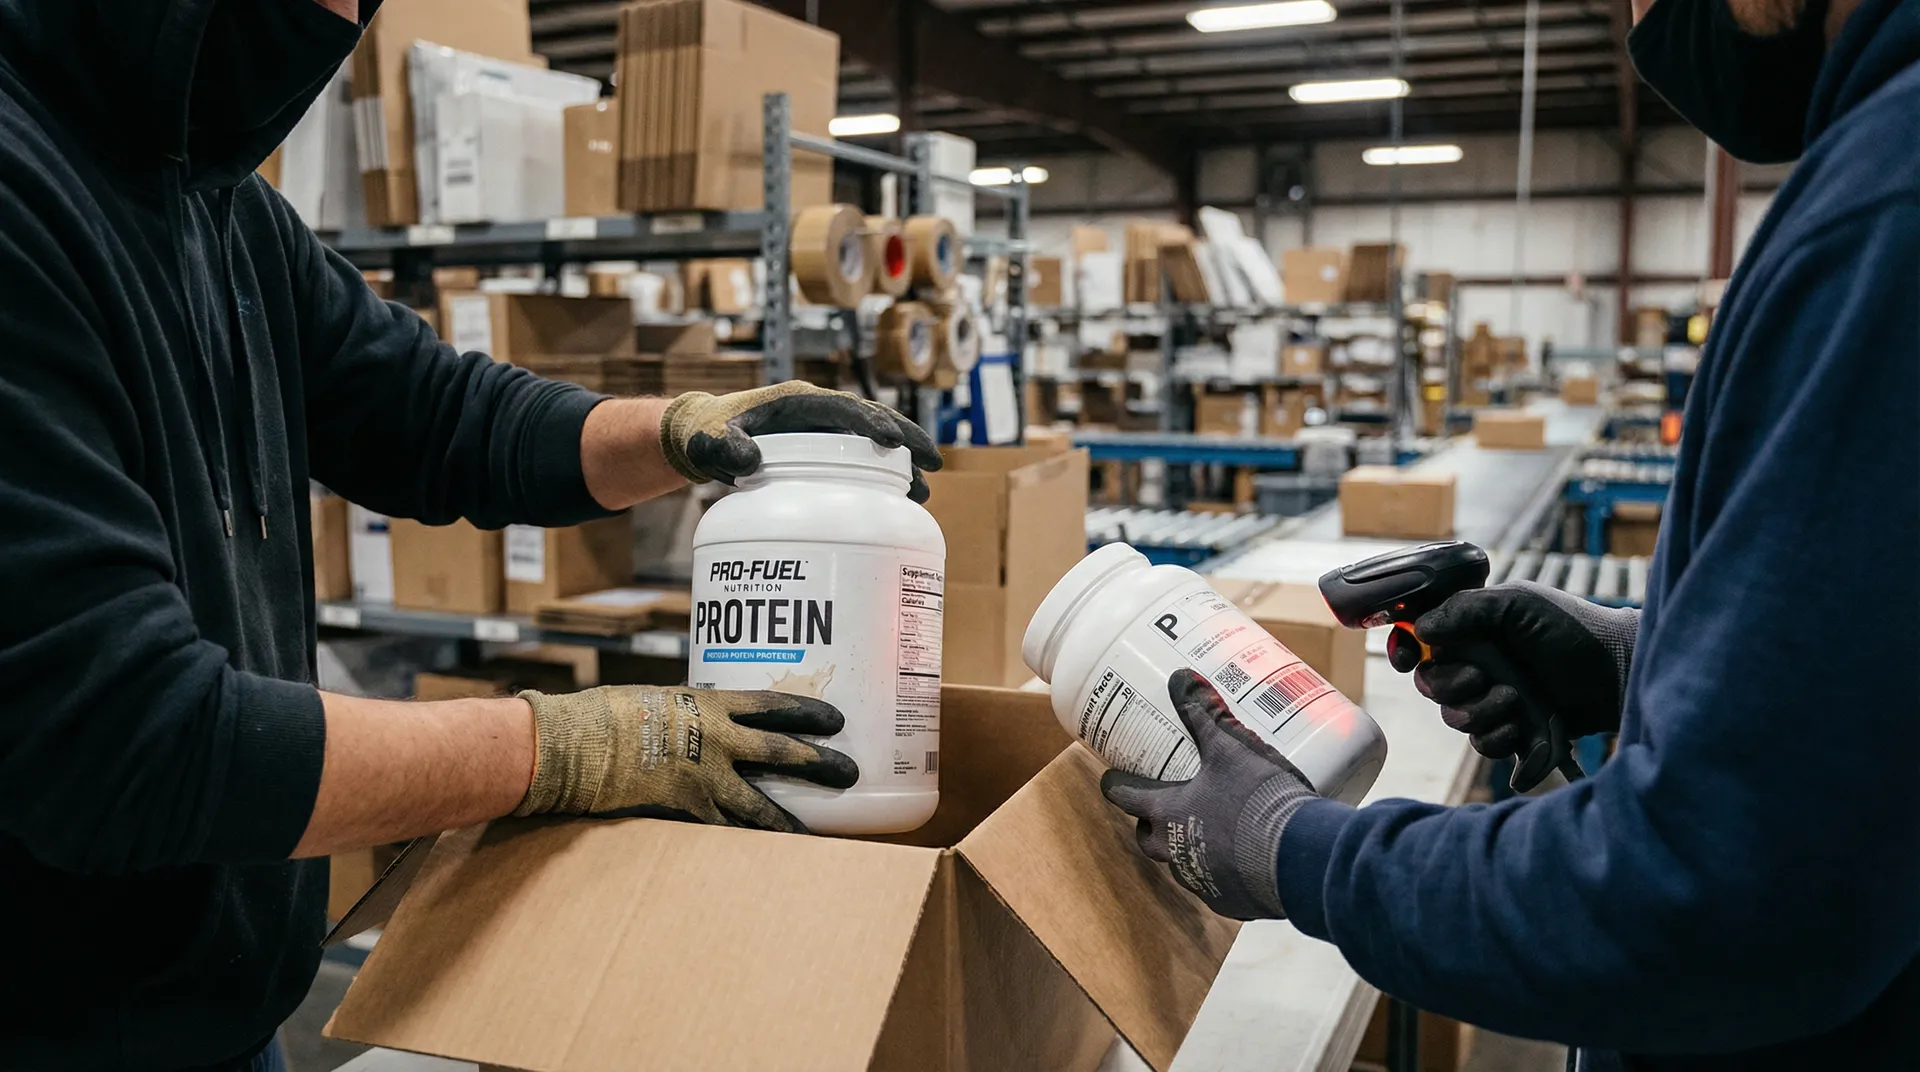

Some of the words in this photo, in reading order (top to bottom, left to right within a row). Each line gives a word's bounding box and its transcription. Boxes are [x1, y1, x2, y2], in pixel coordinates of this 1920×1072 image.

[710, 560, 808, 583] PRO-FUEL
[723, 583, 782, 593] NUTRITION
[696, 599, 833, 646] PROTEIN
[1154, 613, 1178, 641] P
[688, 727, 700, 758] FUEL
